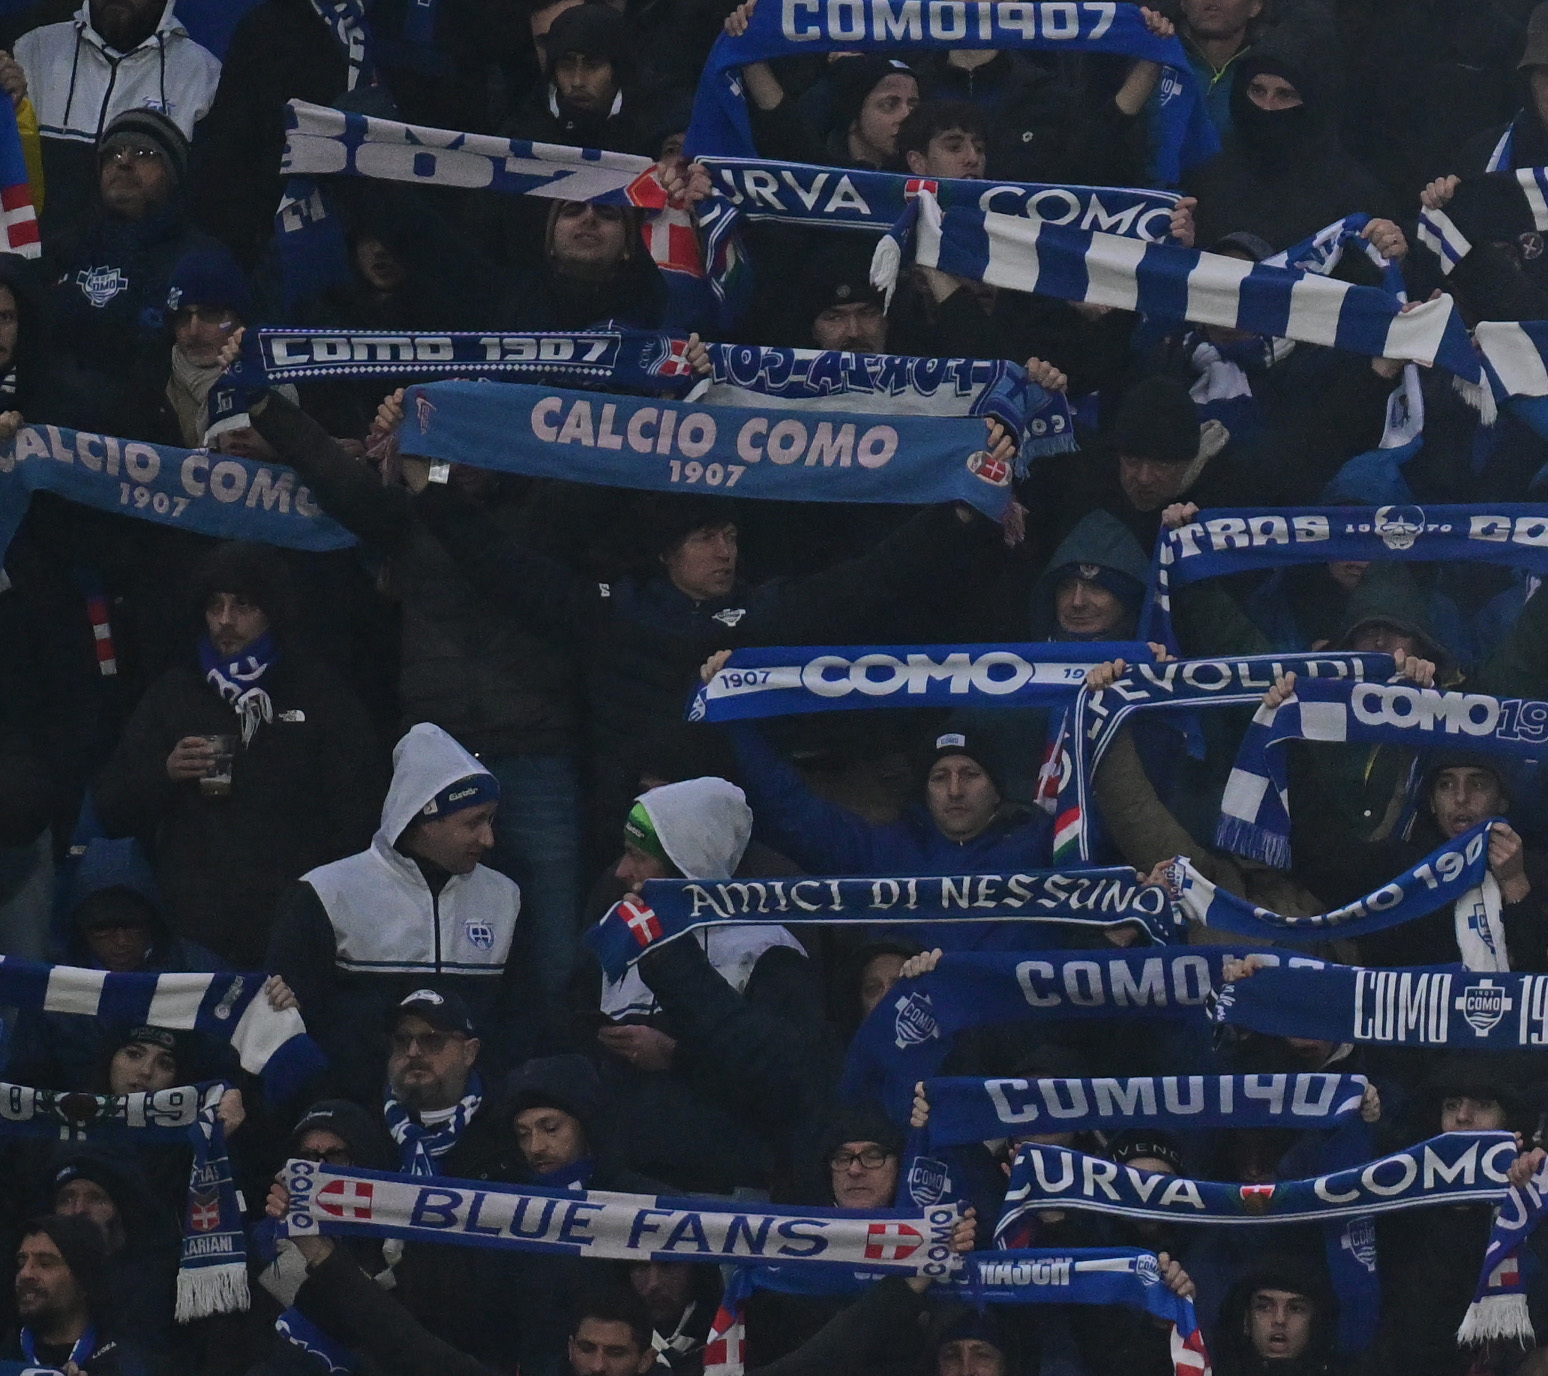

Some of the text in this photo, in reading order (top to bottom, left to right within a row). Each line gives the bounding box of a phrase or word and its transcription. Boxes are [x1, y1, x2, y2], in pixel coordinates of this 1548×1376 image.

[271, 337, 608, 366] COMO 1907
[530, 397, 899, 469] CALCIO COMO
[120, 482, 190, 518] 1907
[669, 459, 746, 488] 1907
[720, 649, 1036, 700] 1907 COMO
[682, 873, 1169, 920] AMICI DI NESSUNO
[1354, 969, 1450, 1046] COMO
[289, 1162, 315, 1229] COMO
[1003, 1136, 1518, 1211] CURVA COMO
[408, 1185, 832, 1261] BLUE FANS
[922, 1206, 953, 1277] COMO
